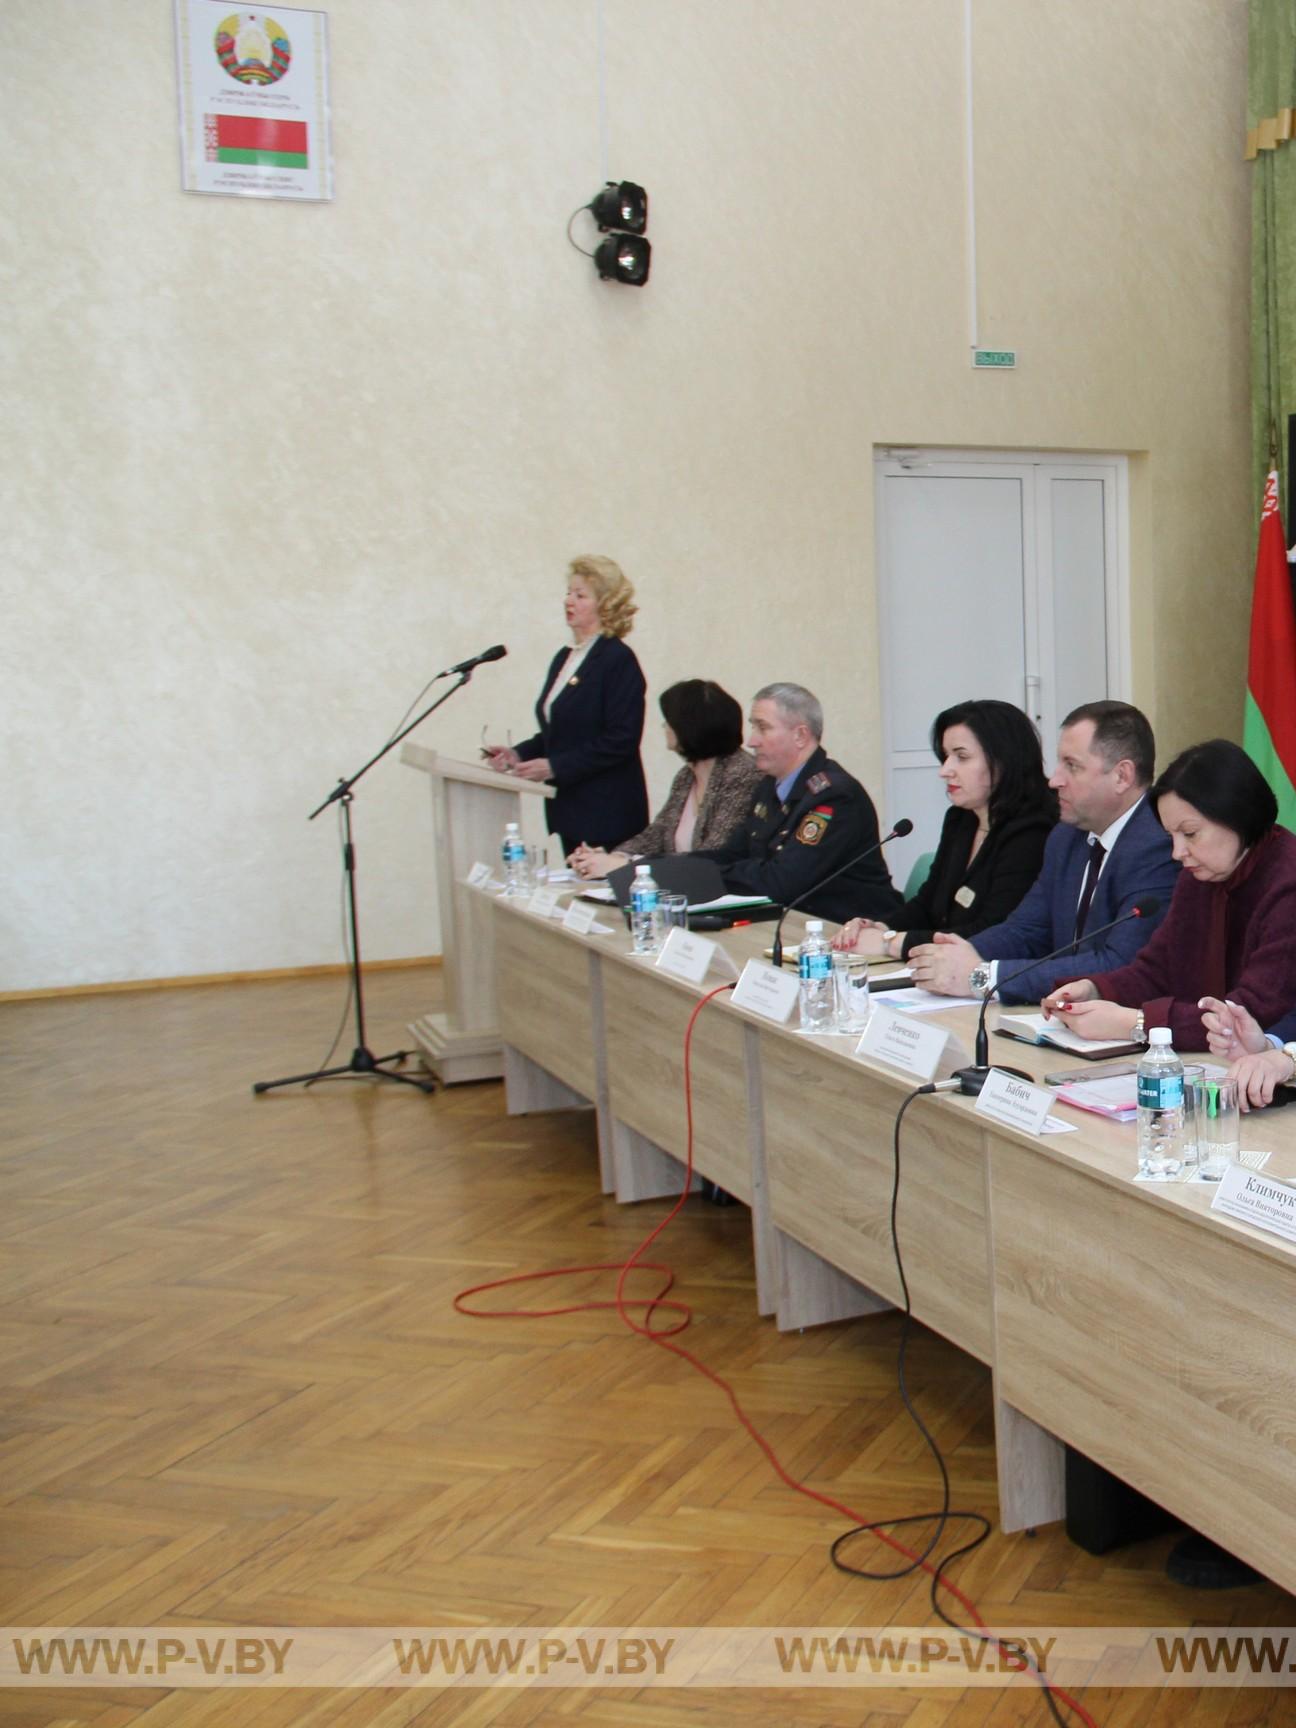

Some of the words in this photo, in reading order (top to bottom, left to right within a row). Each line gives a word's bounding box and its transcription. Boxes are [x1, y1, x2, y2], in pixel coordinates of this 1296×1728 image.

[1005, 1081, 1031, 1100] Бабич
[1236, 1192, 1254, 1206] Ольга
[1255, 1199, 1294, 1222] Викторовна
[1245, 1177, 1296, 1207] Климчук
